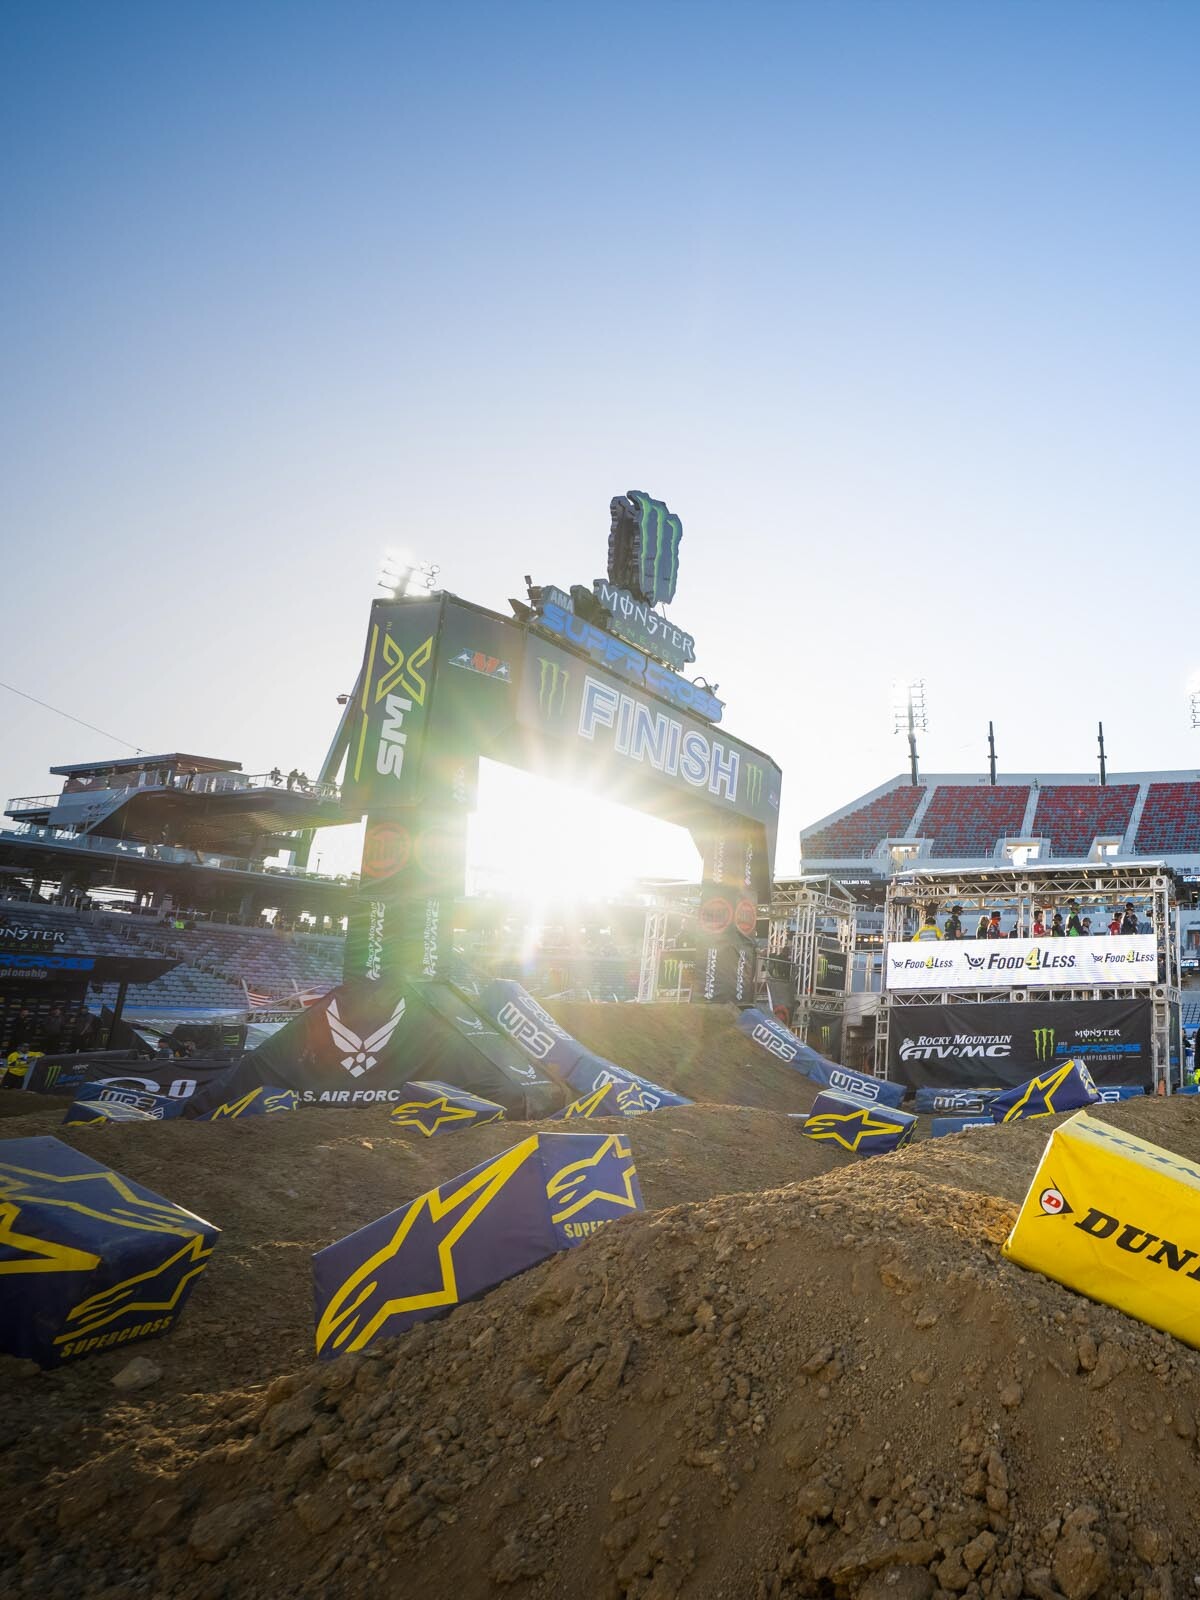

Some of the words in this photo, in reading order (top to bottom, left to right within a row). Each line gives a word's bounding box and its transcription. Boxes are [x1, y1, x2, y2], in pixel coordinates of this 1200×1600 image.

[601, 584, 695, 659] MONSTER
[543, 603, 723, 721] SUPERCROSS
[578, 675, 740, 801] FINISH
[497, 1002, 555, 1058] WPS
[752, 1024, 797, 1062] WPS
[917, 1036, 951, 1045] ROCKY
[953, 1034, 1012, 1044] MOUNTAIN
[1075, 1028, 1121, 1038] MONSTER
[297, 1090, 316, 1102] .S.
[320, 1090, 350, 1102] AIR
[351, 1090, 401, 1102] FORC
[829, 1070, 880, 1101] WPS
[1043, 1195, 1061, 1209] D
[564, 1219, 613, 1238] SUPE
[60, 1316, 173, 1358] SUPERCROSS
